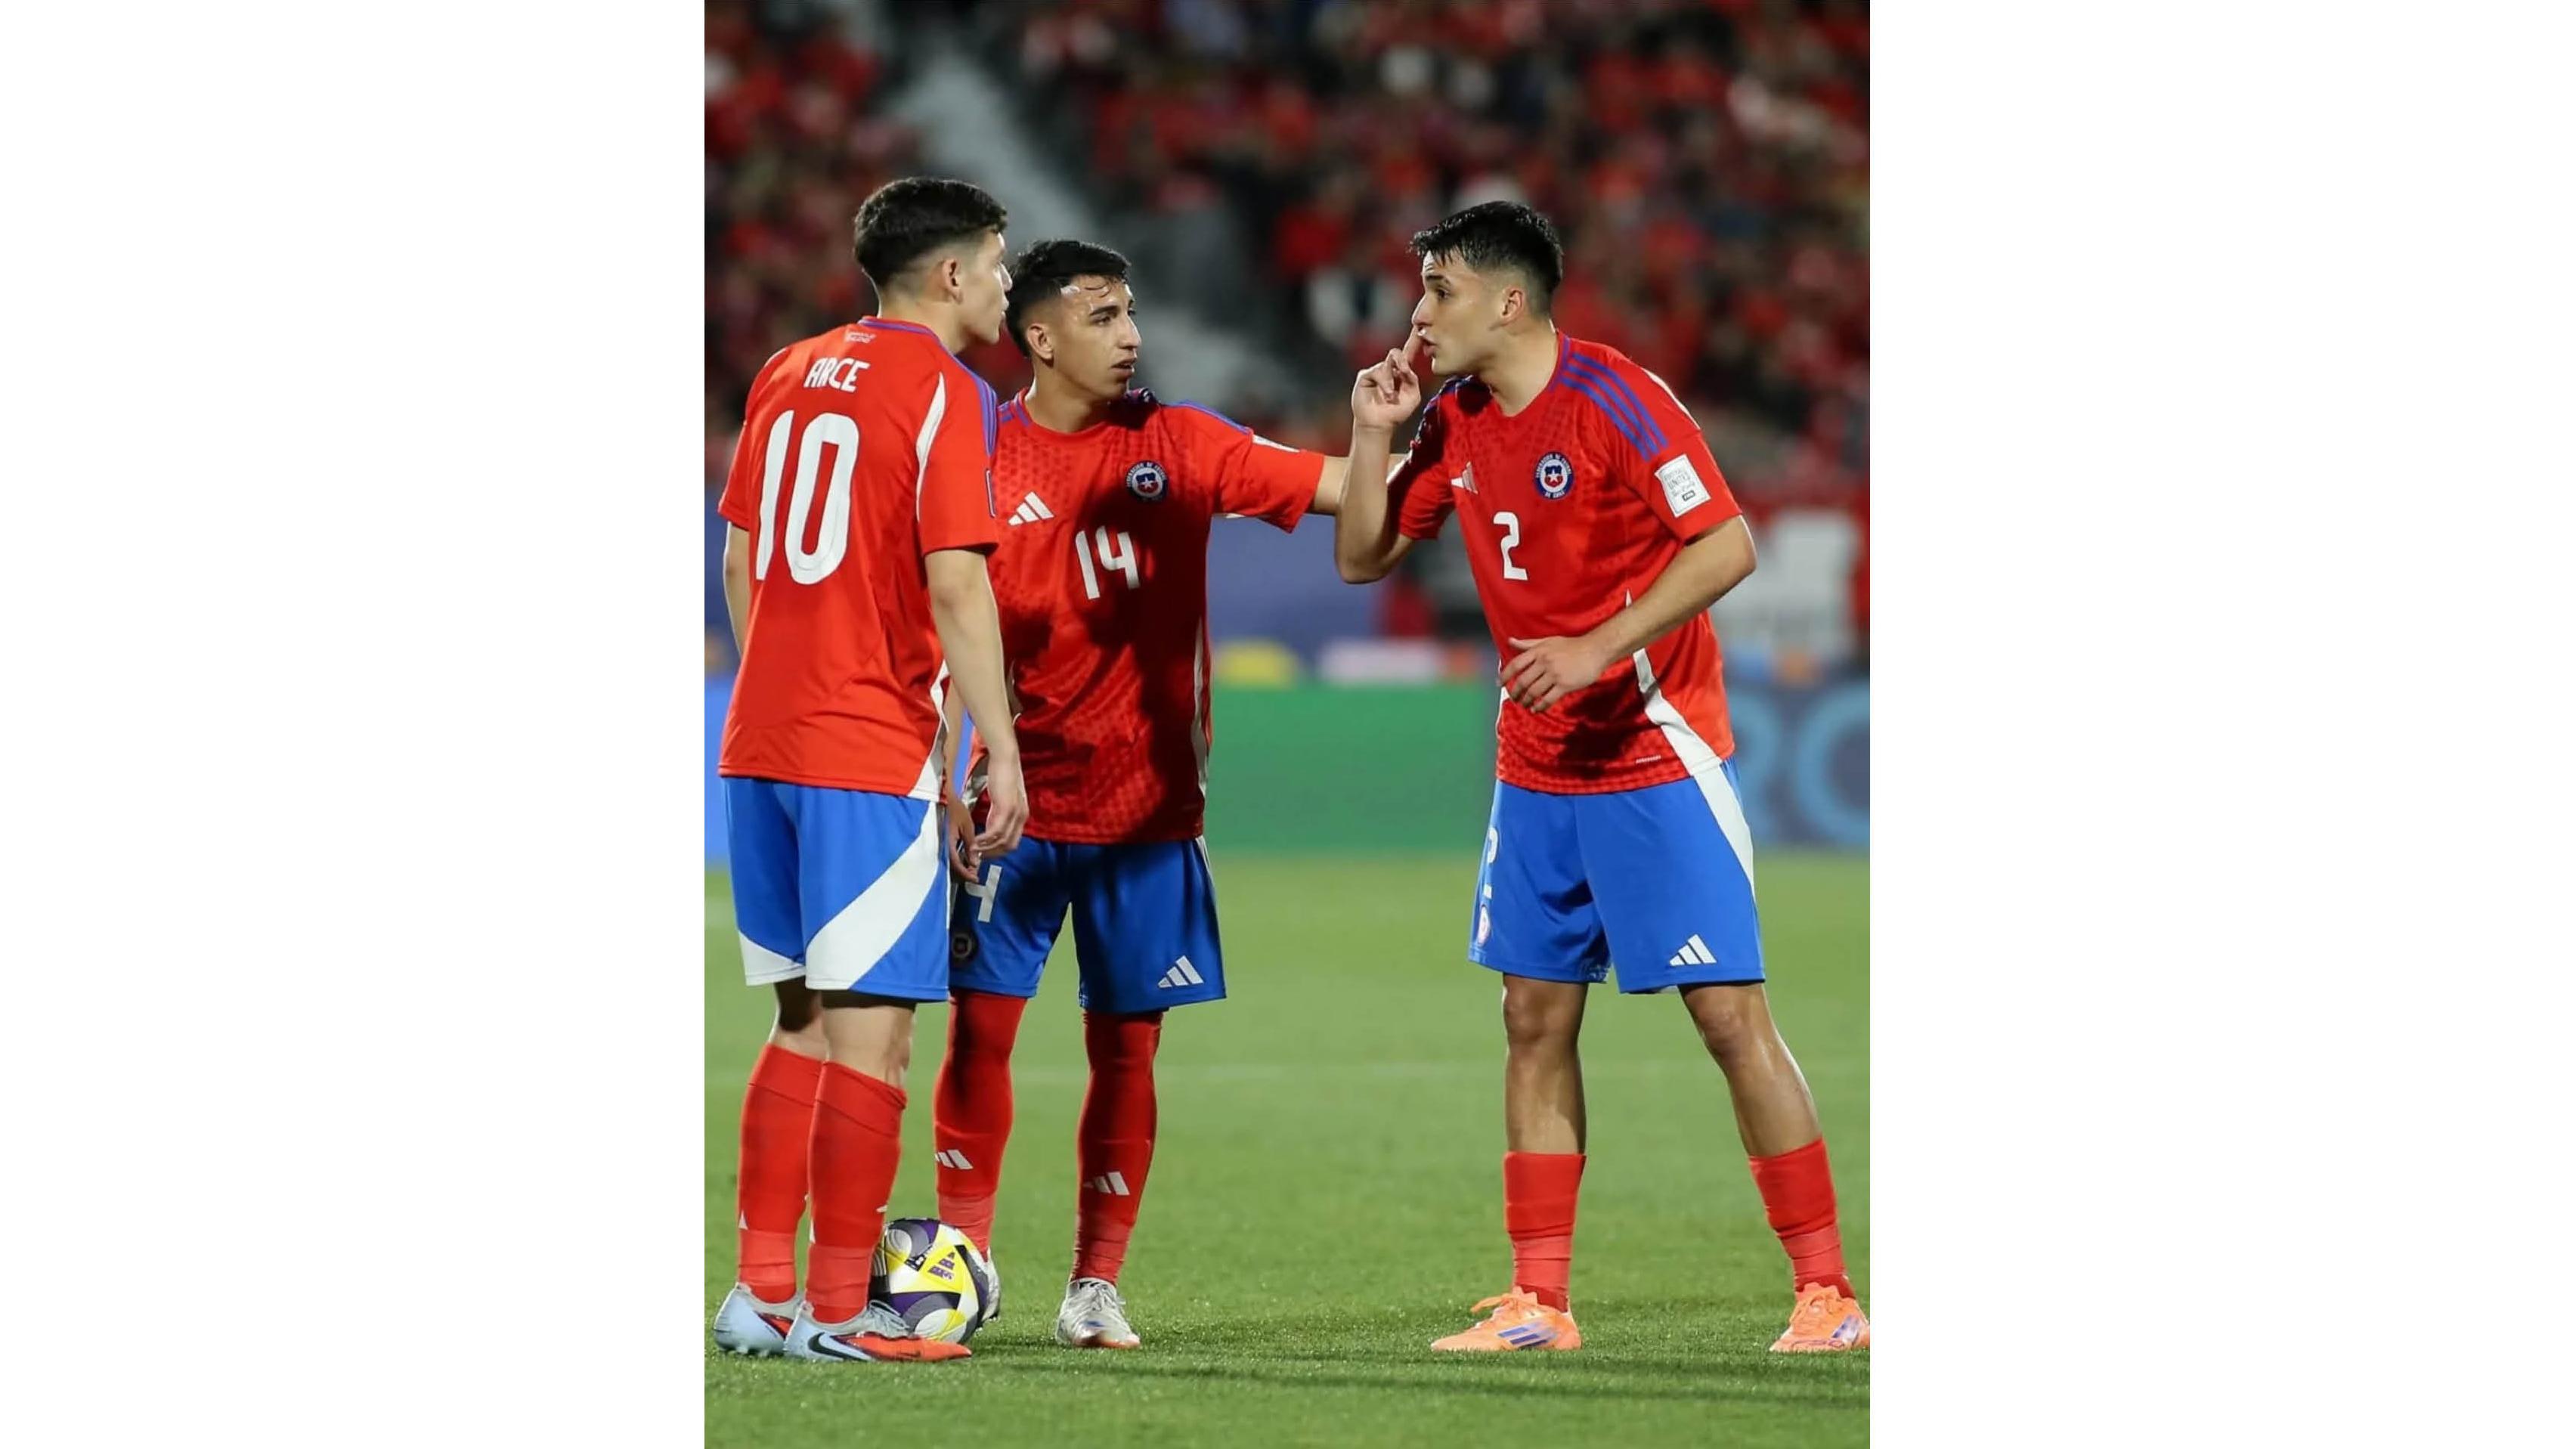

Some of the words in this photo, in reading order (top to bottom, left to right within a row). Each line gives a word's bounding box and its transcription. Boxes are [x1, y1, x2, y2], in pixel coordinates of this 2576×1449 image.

[803, 357, 871, 393] ARCE
[756, 409, 859, 585] 10
[1075, 525, 1140, 599] 14
[1493, 511, 1528, 581] 2
